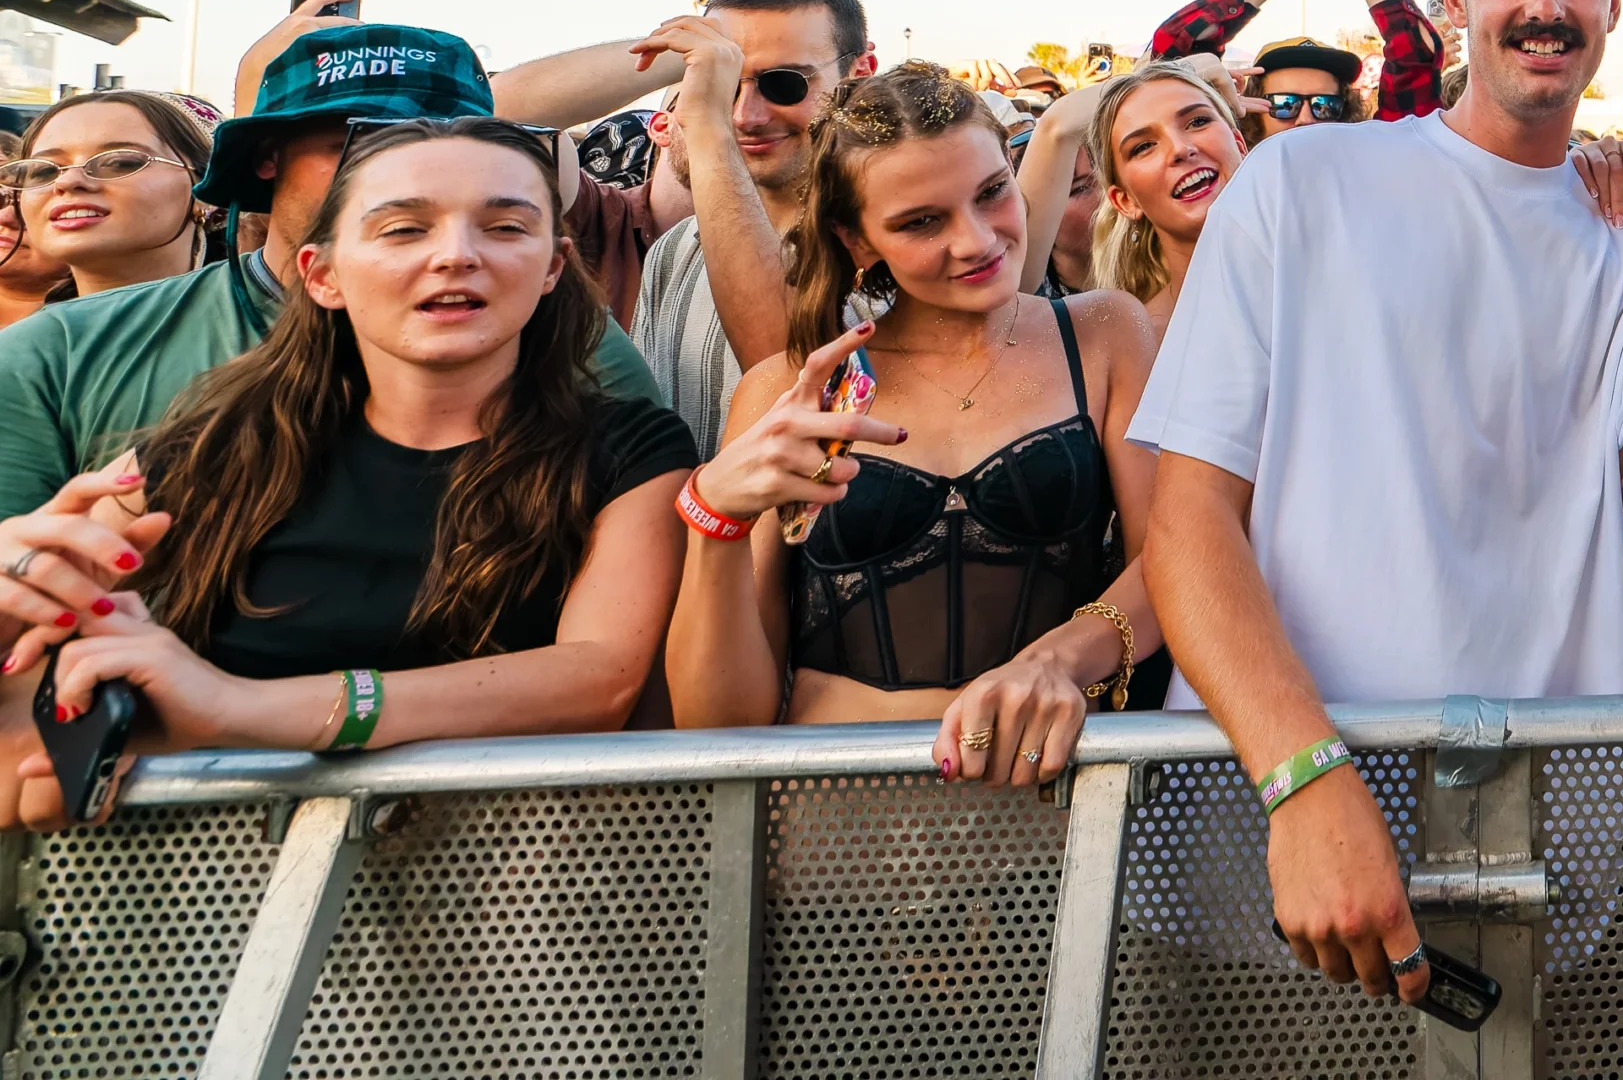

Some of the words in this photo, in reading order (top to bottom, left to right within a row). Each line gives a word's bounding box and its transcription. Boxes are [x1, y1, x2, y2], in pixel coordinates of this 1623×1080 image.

[316, 46, 437, 70] BUNNINGS
[317, 59, 406, 87] TRADE
[1312, 748, 1330, 768] GA
[1328, 741, 1350, 760] WE
